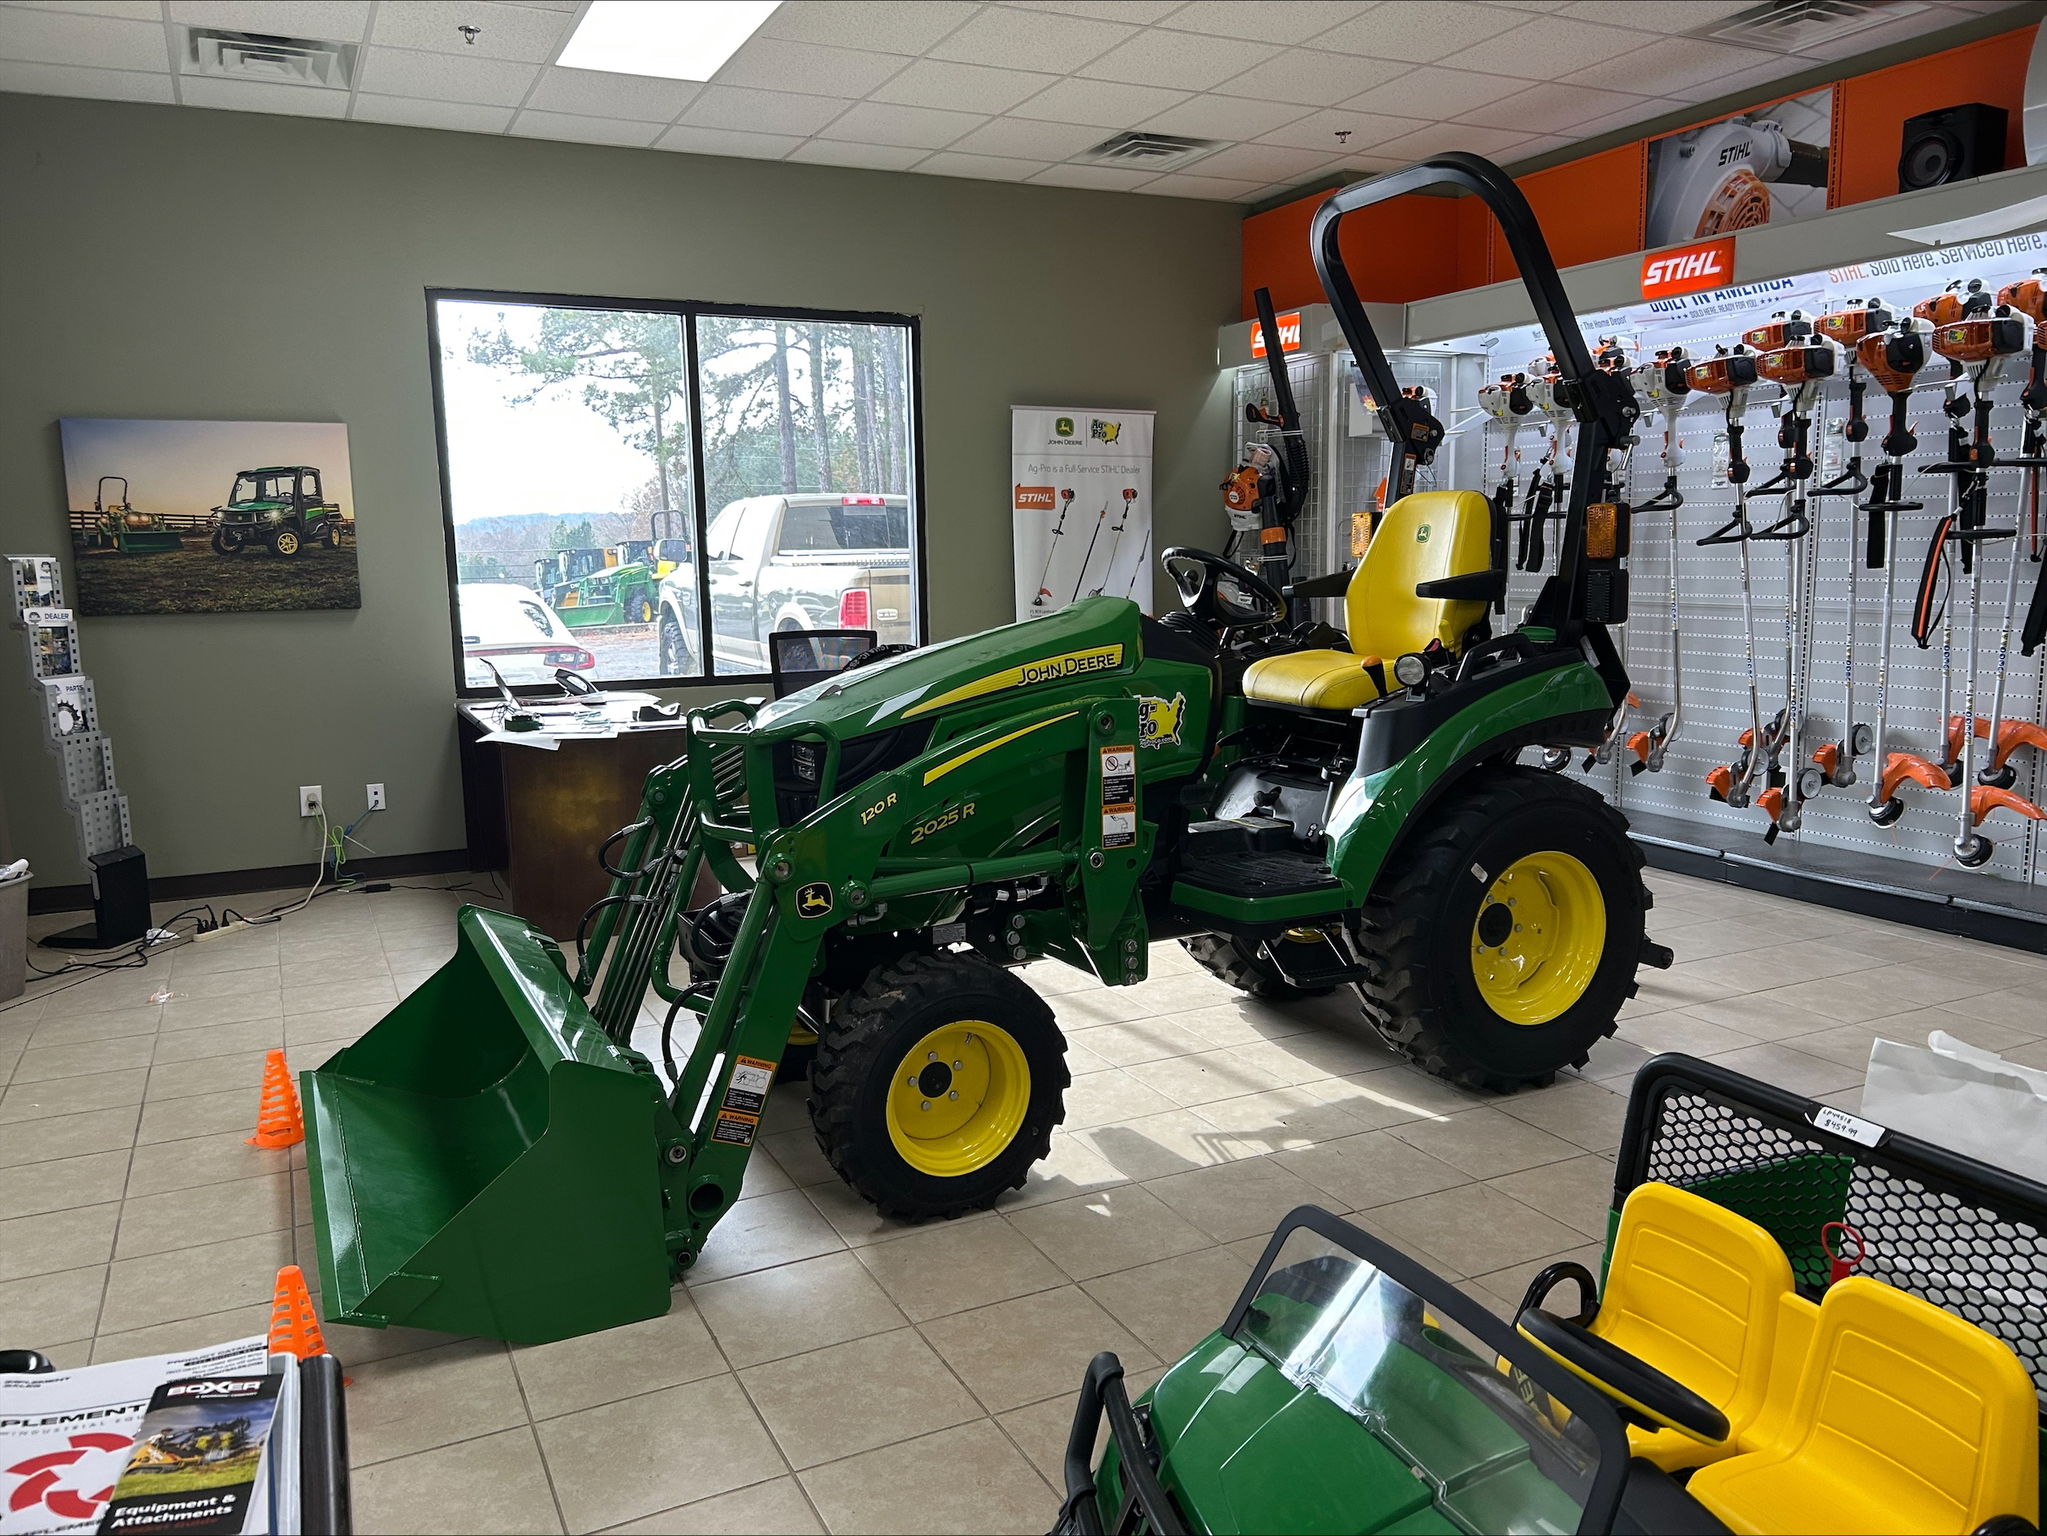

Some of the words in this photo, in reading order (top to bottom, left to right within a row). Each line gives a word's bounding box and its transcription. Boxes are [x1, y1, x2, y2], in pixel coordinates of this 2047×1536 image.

[1718, 141, 1751, 167] STIHL
[1643, 251, 1721, 287] STIHL
[1870, 258, 1901, 277] Sold
[1902, 252, 1938, 272] Here.
[1690, 308, 1704, 318] SOLD
[1719, 303, 1735, 314] READY
[1735, 301, 1747, 311] FOR
[1584, 320, 1594, 331] The
[1594, 318, 1610, 329] Home
[1610, 315, 1627, 327] Depot
[1091, 429, 1107, 439] Pro
[1028, 464, 1051, 475] Ag-Pro
[1052, 464, 1058, 473] is
[1065, 464, 1100, 474] Full-Service
[1101, 465, 1119, 474] STIHL
[1121, 465, 1141, 474] Dealer
[1018, 493, 1052, 503] STIHL
[1018, 662, 1062, 686] JOHN
[1064, 653, 1117, 675] DEERE
[860, 800, 885, 825] 120
[887, 792, 898, 807] R
[1108, 805, 1134, 813] WARNING
[910, 809, 959, 845] 2025
[962, 802, 976, 819] R
[747, 1058, 771, 1069] WARNING
[729, 1114, 754, 1124] WARNING
[1824, 1119, 1858, 1137] $459.99
[167, 1352, 215, 1365] PRODUCT
[217, 1342, 263, 1356] CATALOG
[167, 1381, 261, 1396] BOXER
[115, 1497, 218, 1517] Equipment
[222, 1494, 236, 1504] &
[110, 1505, 233, 1529] Attachments
